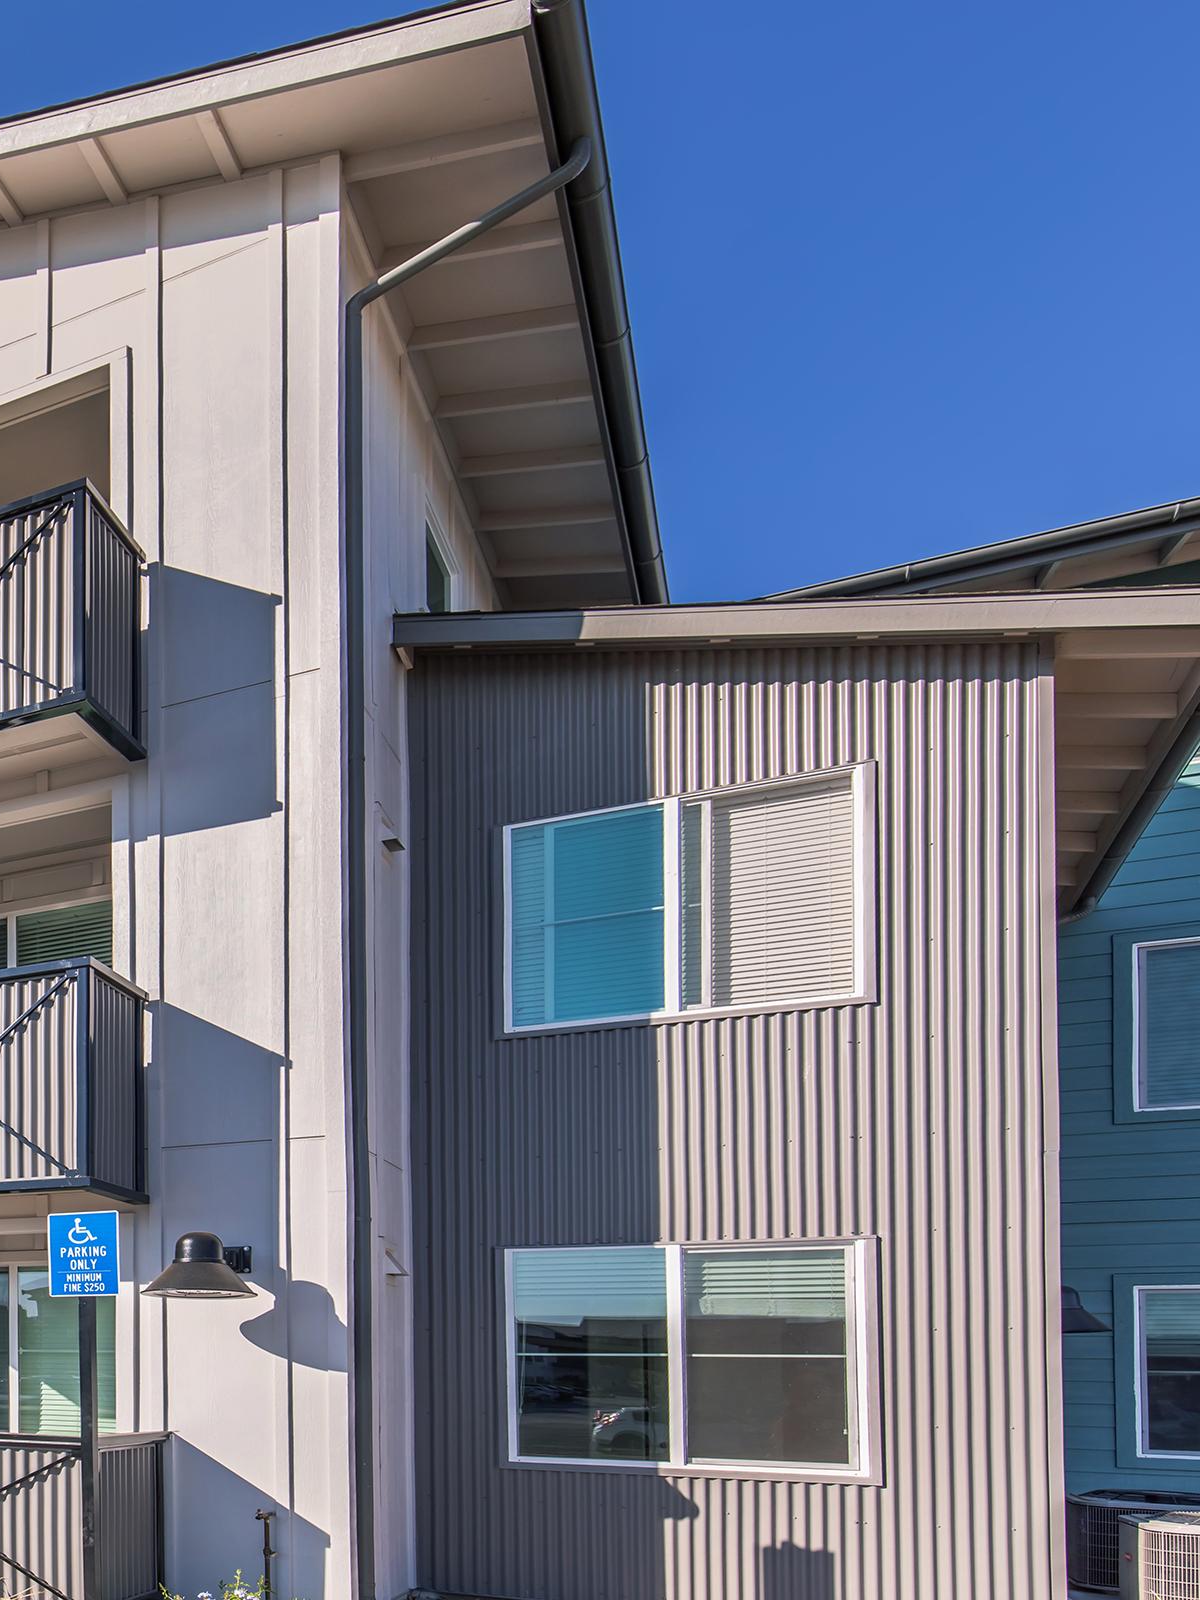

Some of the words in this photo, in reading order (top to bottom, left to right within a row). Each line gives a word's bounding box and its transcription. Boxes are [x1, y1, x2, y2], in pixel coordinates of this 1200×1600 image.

[60, 1245, 107, 1258] PARKING
[70, 1259, 98, 1271] ONLY
[66, 1273, 102, 1282] MINIMUM
[63, 1283, 82, 1292] FINE
[84, 1282, 106, 1292] $250
